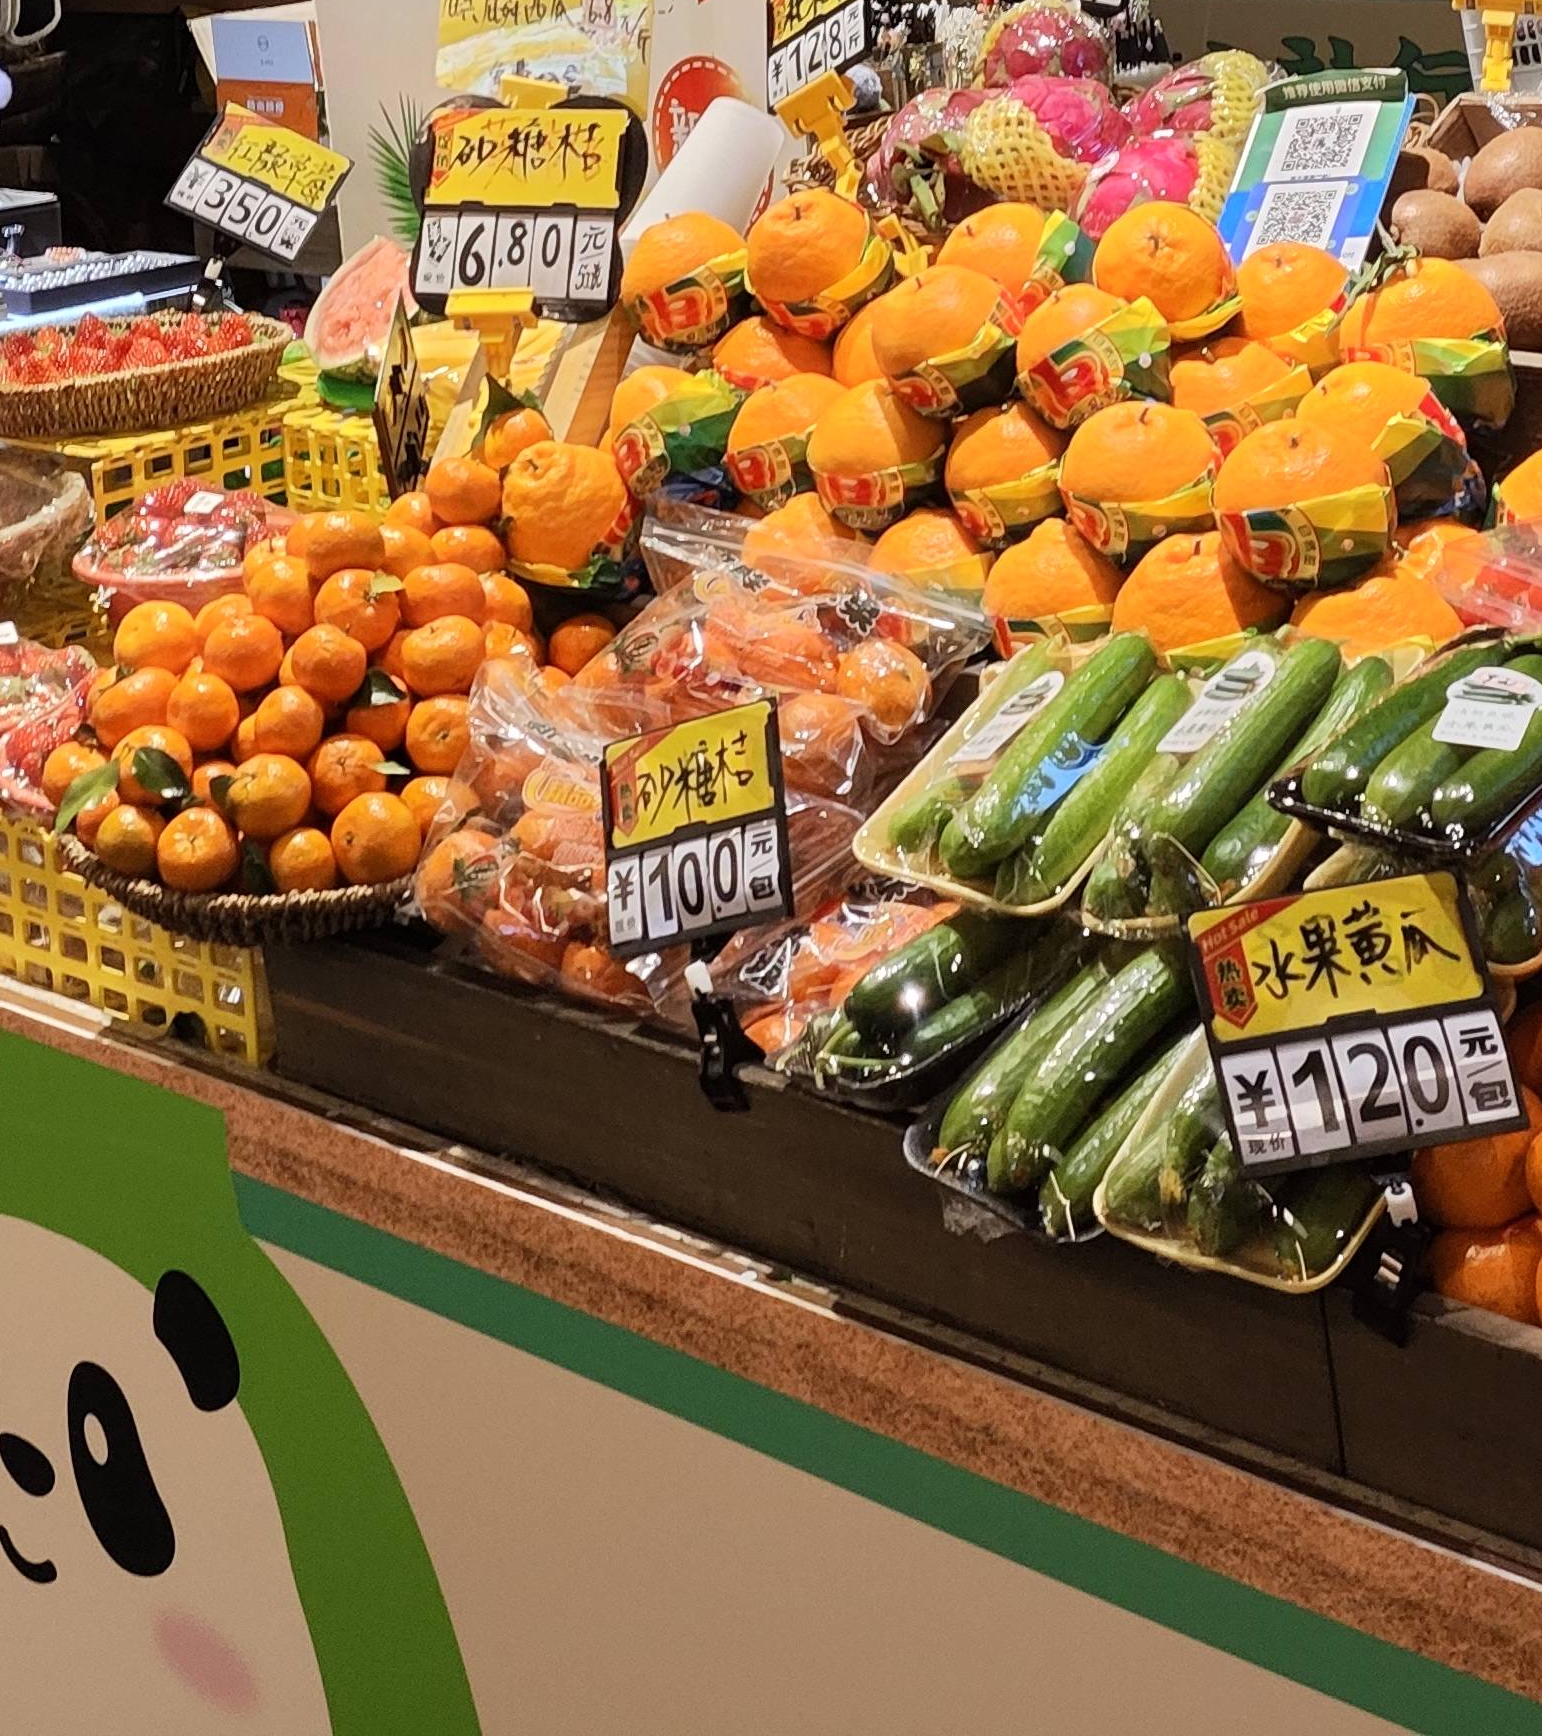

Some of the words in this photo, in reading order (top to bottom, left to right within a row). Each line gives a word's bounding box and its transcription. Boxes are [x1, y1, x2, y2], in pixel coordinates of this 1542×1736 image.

[1282, 74, 1388, 100] 推荐使用微信支付
[1201, 928, 1228, 952] Hot
[1228, 909, 1260, 933] Sale
[1250, 899, 1462, 1000] 水果黄瓜
[1216, 960, 1249, 1012] 热卖
